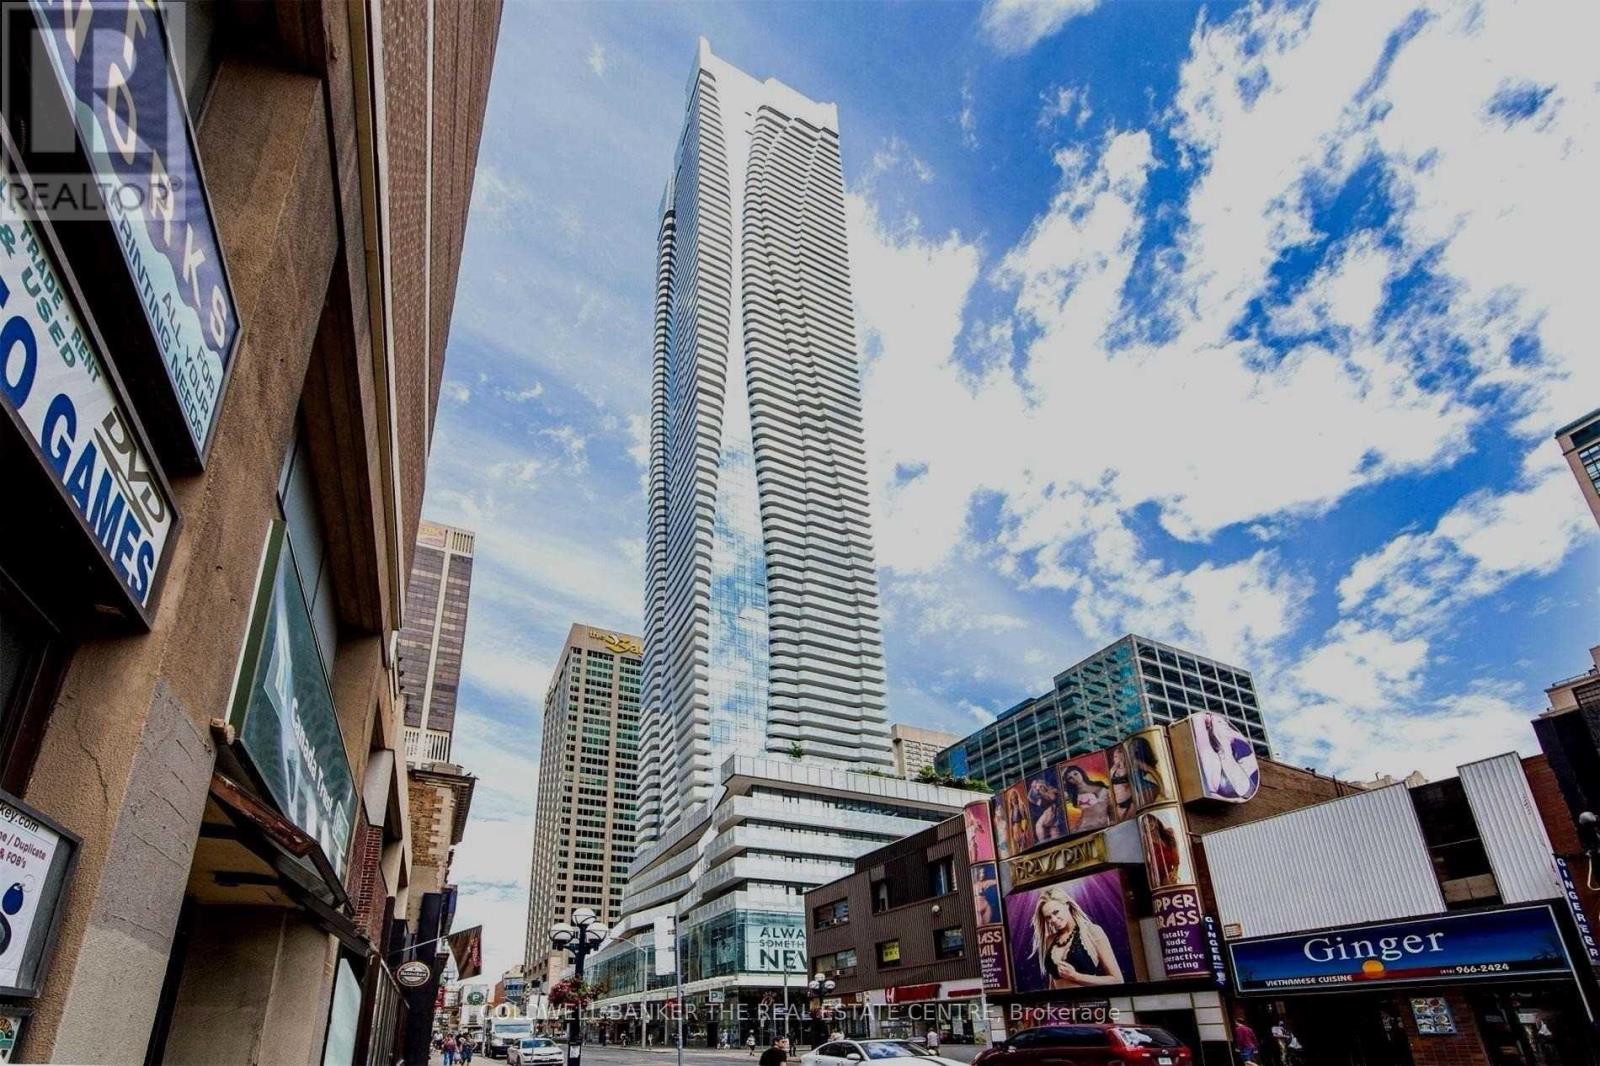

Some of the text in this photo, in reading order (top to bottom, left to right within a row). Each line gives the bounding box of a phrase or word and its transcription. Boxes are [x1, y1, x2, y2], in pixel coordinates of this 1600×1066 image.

[20, 219, 101, 384] TRADE RENT
[21, 265, 76, 369] USED
[161, 292, 209, 422] ALL YOUR
[171, 353, 203, 443] NEEDS
[195, 344, 214, 399] FOR
[41, 393, 155, 606] GAMES
[291, 697, 318, 782] Canada
[14, 836, 47, 861] Duplicate
[1265, 974, 1353, 988] VIETNAMESE CUISINE
[1303, 930, 1444, 963] Ginger
[1456, 962, 1509, 975] 966-2424
